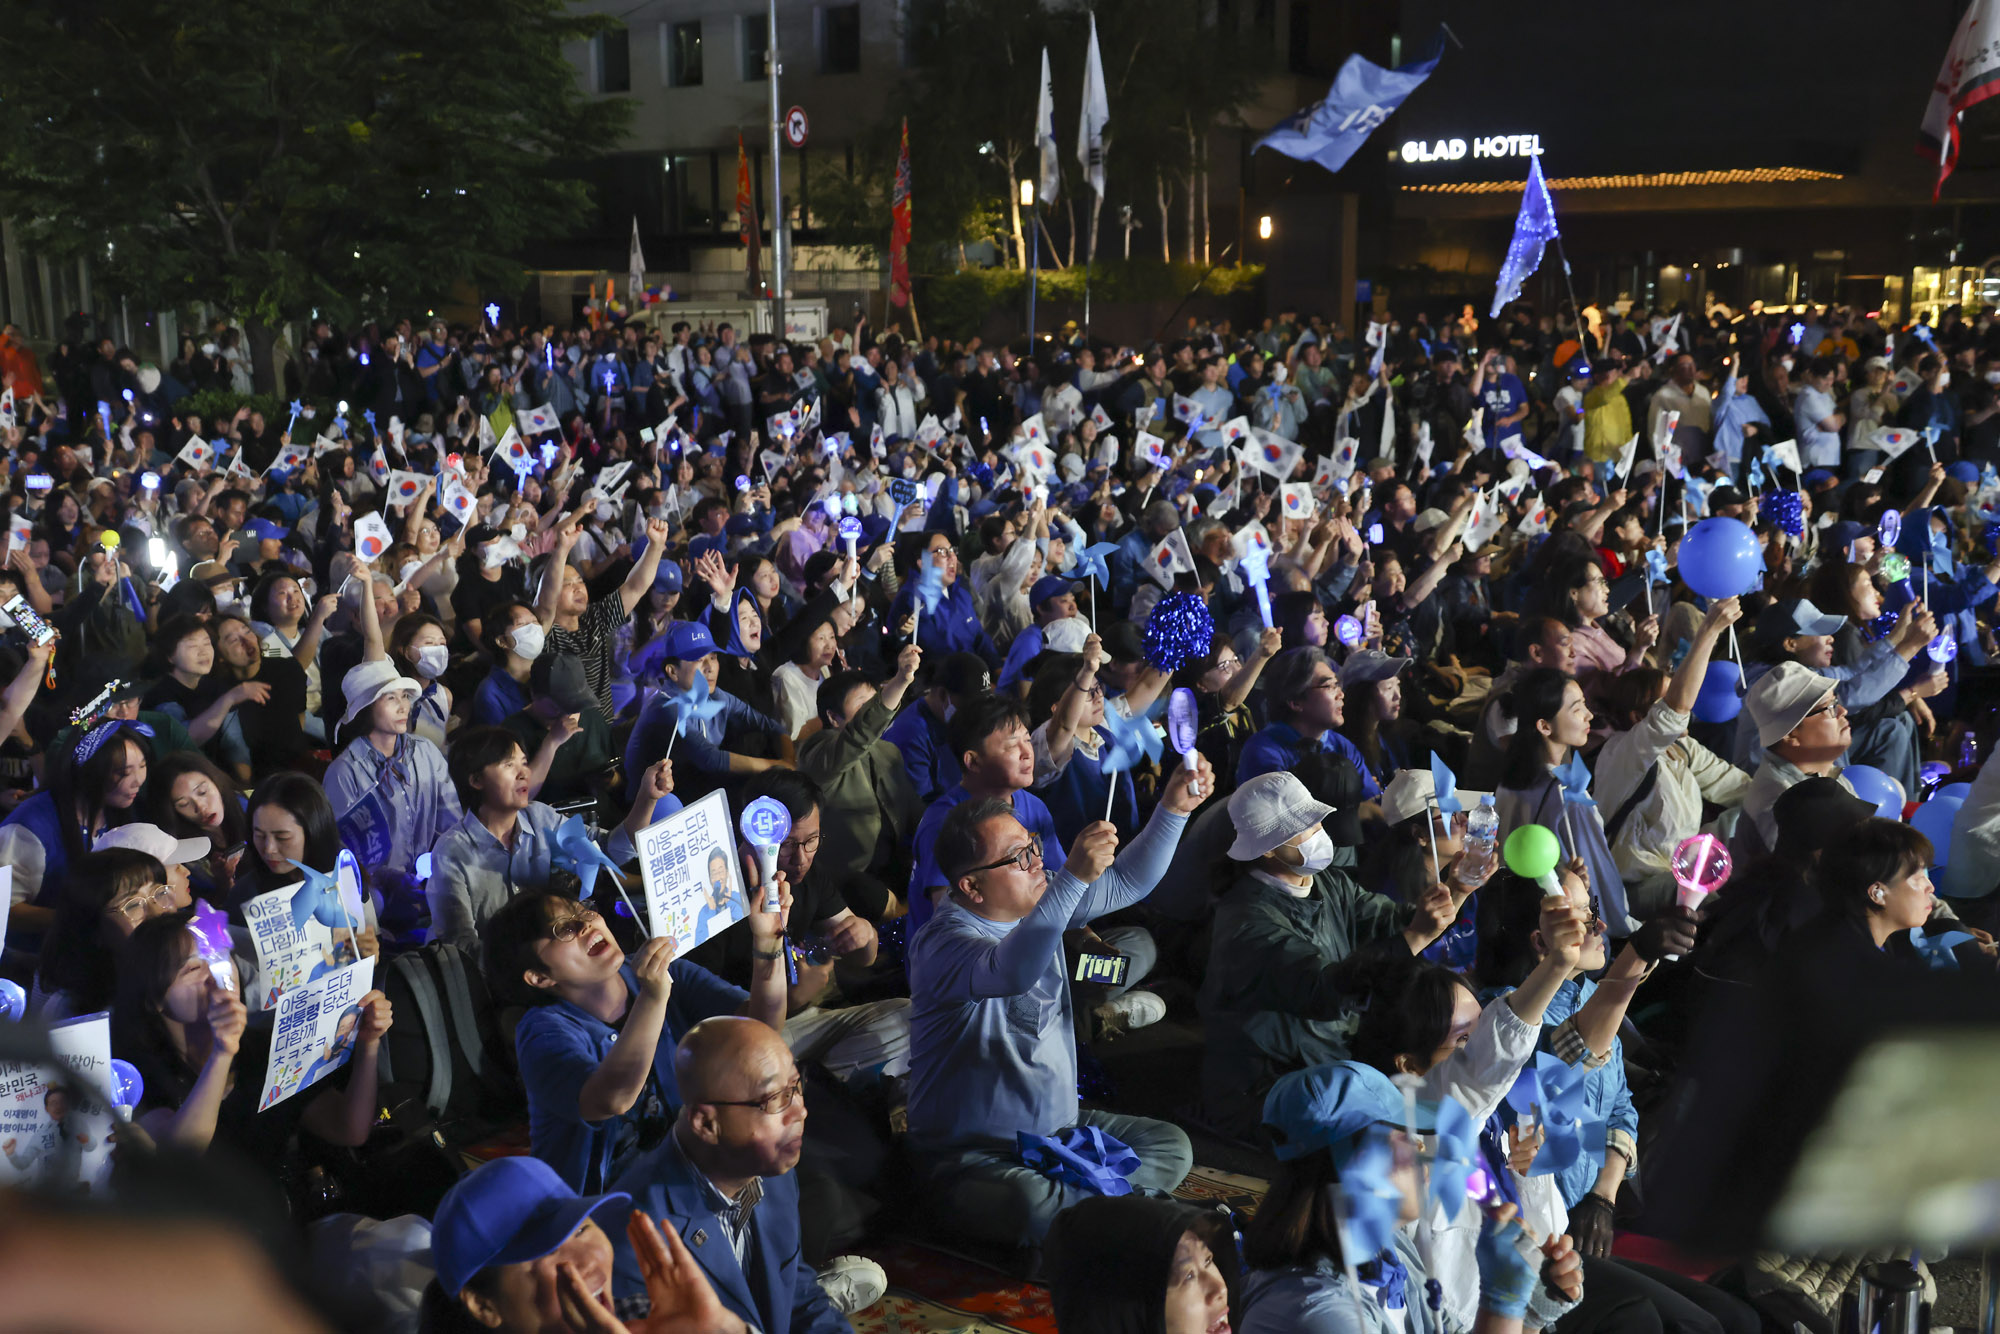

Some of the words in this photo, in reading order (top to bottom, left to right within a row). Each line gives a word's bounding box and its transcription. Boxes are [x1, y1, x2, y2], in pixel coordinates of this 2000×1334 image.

[1401, 138, 1467, 163] GLAD
[1473, 134, 1544, 158] HOTEL
[691, 632, 706, 641] LEE
[685, 809, 708, 836] 드뎌
[649, 843, 687, 878] 잼통령
[653, 863, 691, 897] 다함께
[260, 927, 307, 956] 다함께
[326, 969, 353, 996] 드뎌
[278, 1002, 320, 1035] 잼통령
[275, 1020, 318, 1052] 다함께
